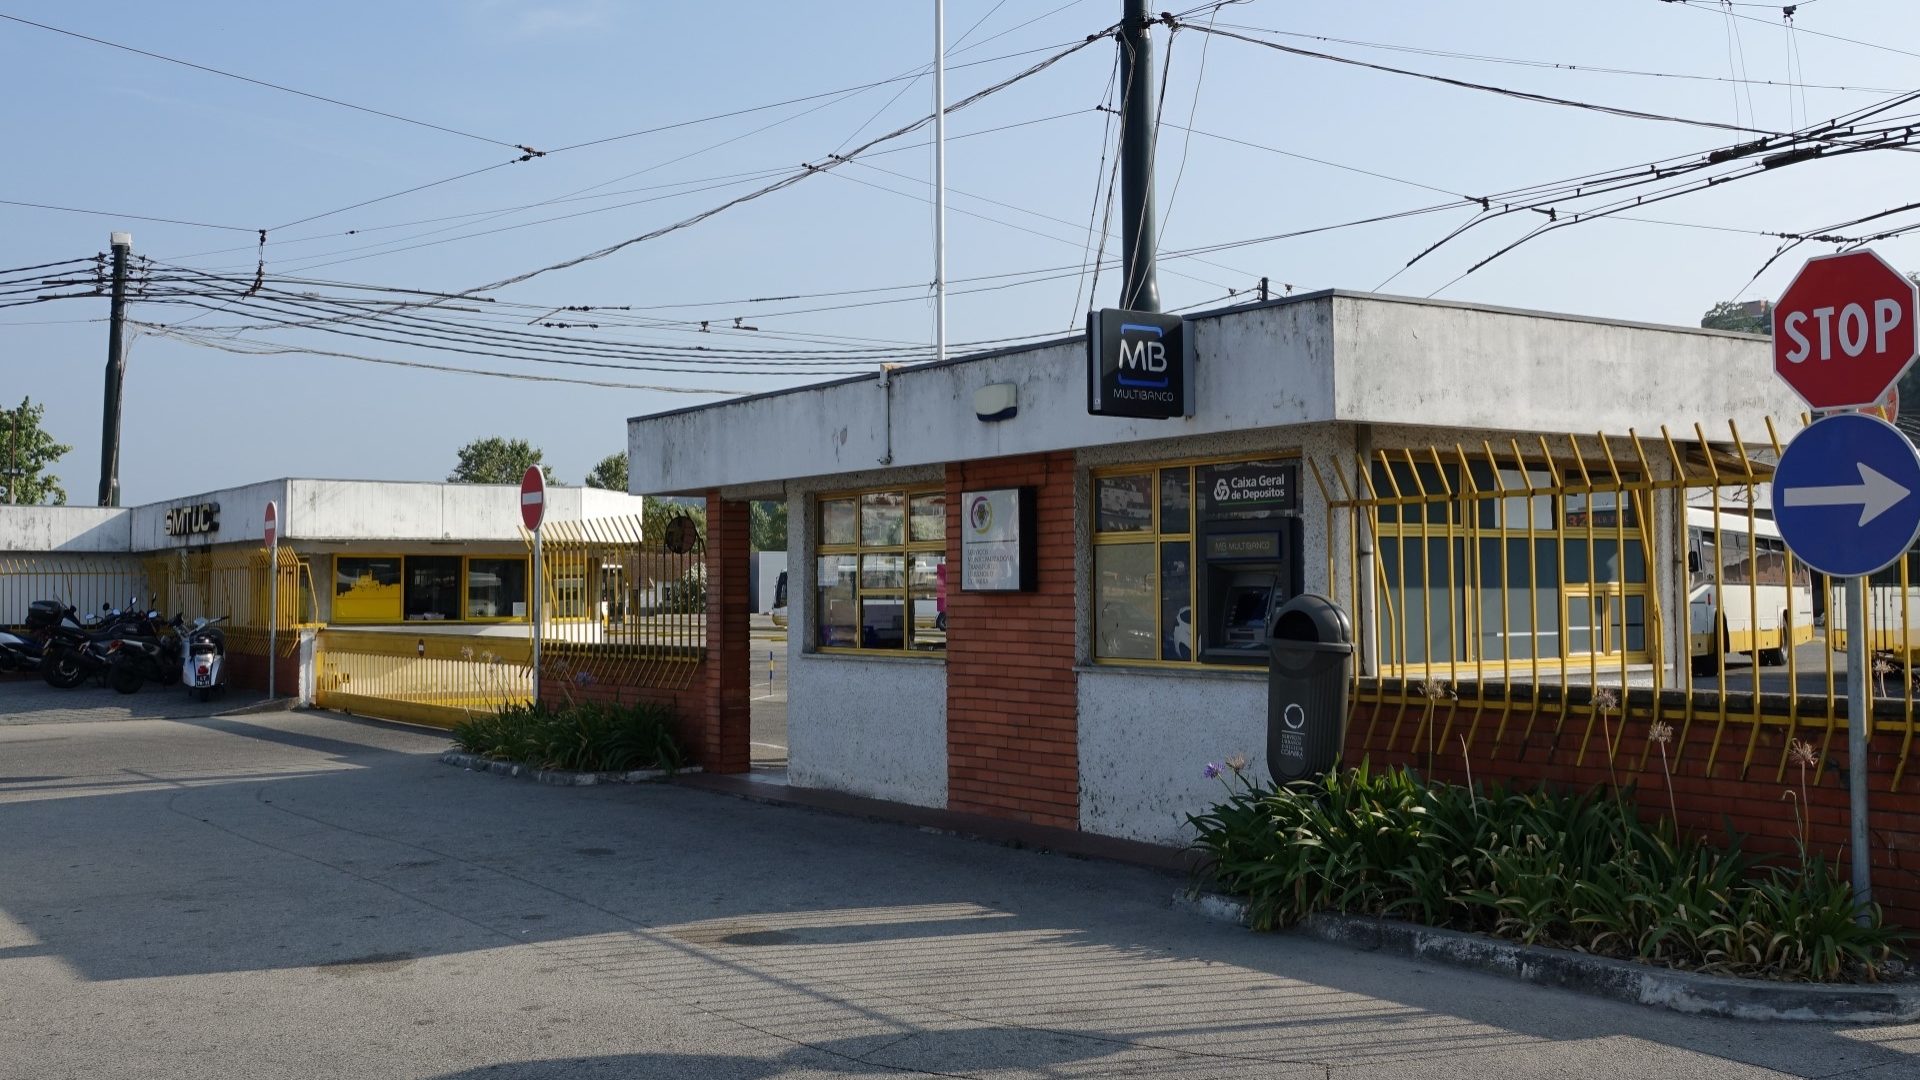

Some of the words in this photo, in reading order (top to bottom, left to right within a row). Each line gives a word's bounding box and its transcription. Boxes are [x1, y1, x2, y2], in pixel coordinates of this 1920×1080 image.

[1784, 298, 1902, 364] STOP
[1118, 338, 1168, 373] MB
[1113, 388, 1174, 402] MULTIBANCO
[1231, 476, 1257, 488] Caixa
[1258, 473, 1285, 487] Geral
[1231, 490, 1241, 500] de
[164, 502, 212, 536] SMTUC
